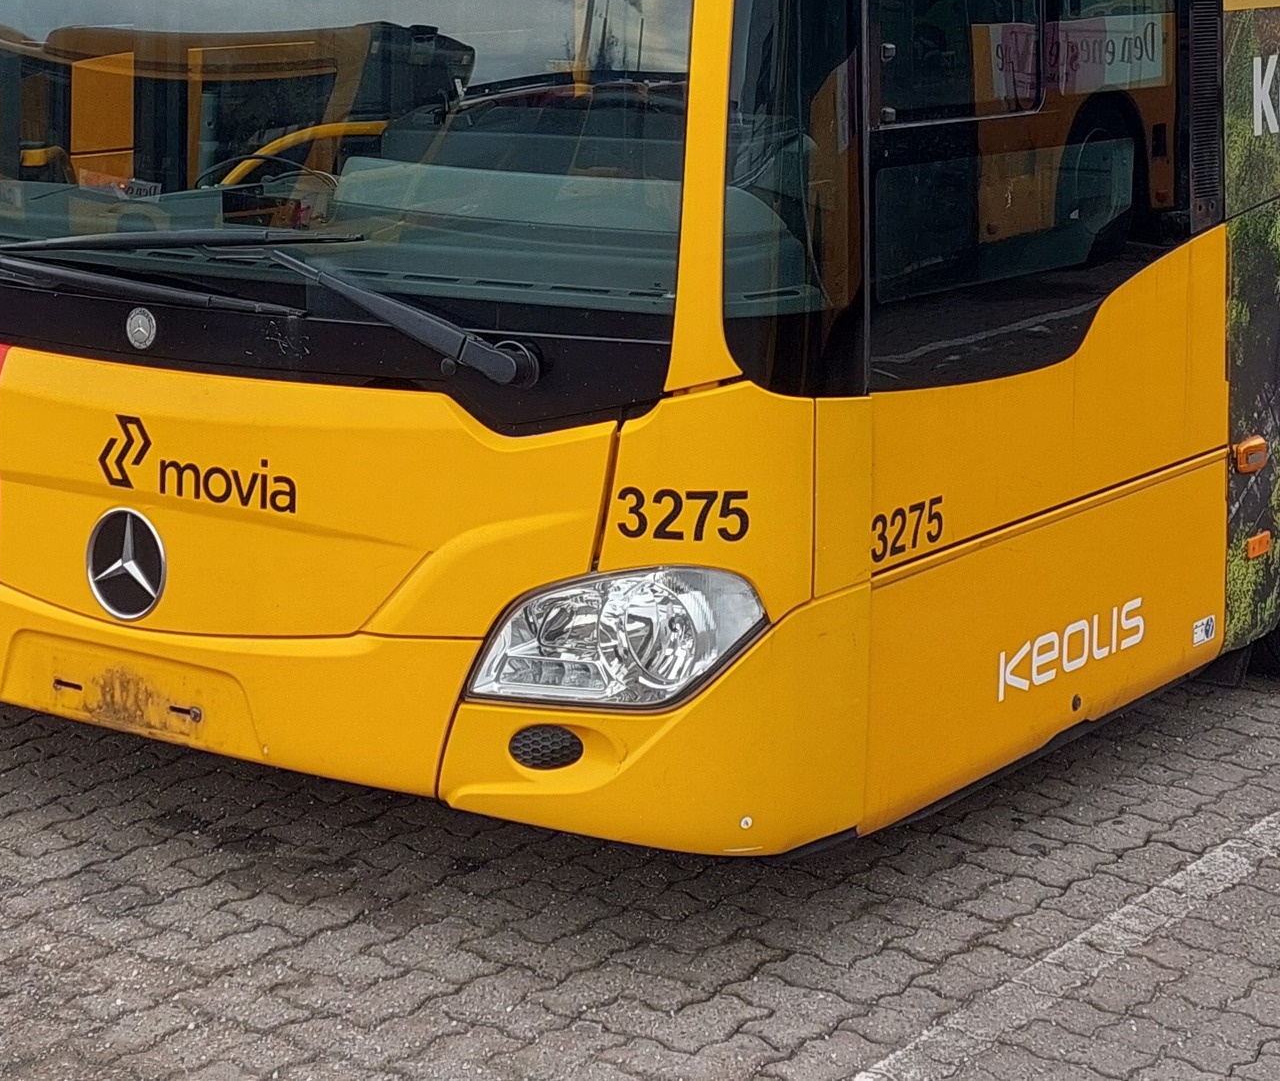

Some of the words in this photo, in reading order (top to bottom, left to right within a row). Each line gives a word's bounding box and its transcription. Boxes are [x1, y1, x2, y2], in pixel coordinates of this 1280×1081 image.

[159, 458, 296, 514] movia
[617, 486, 750, 542] 3275
[871, 495, 943, 563] 3275
